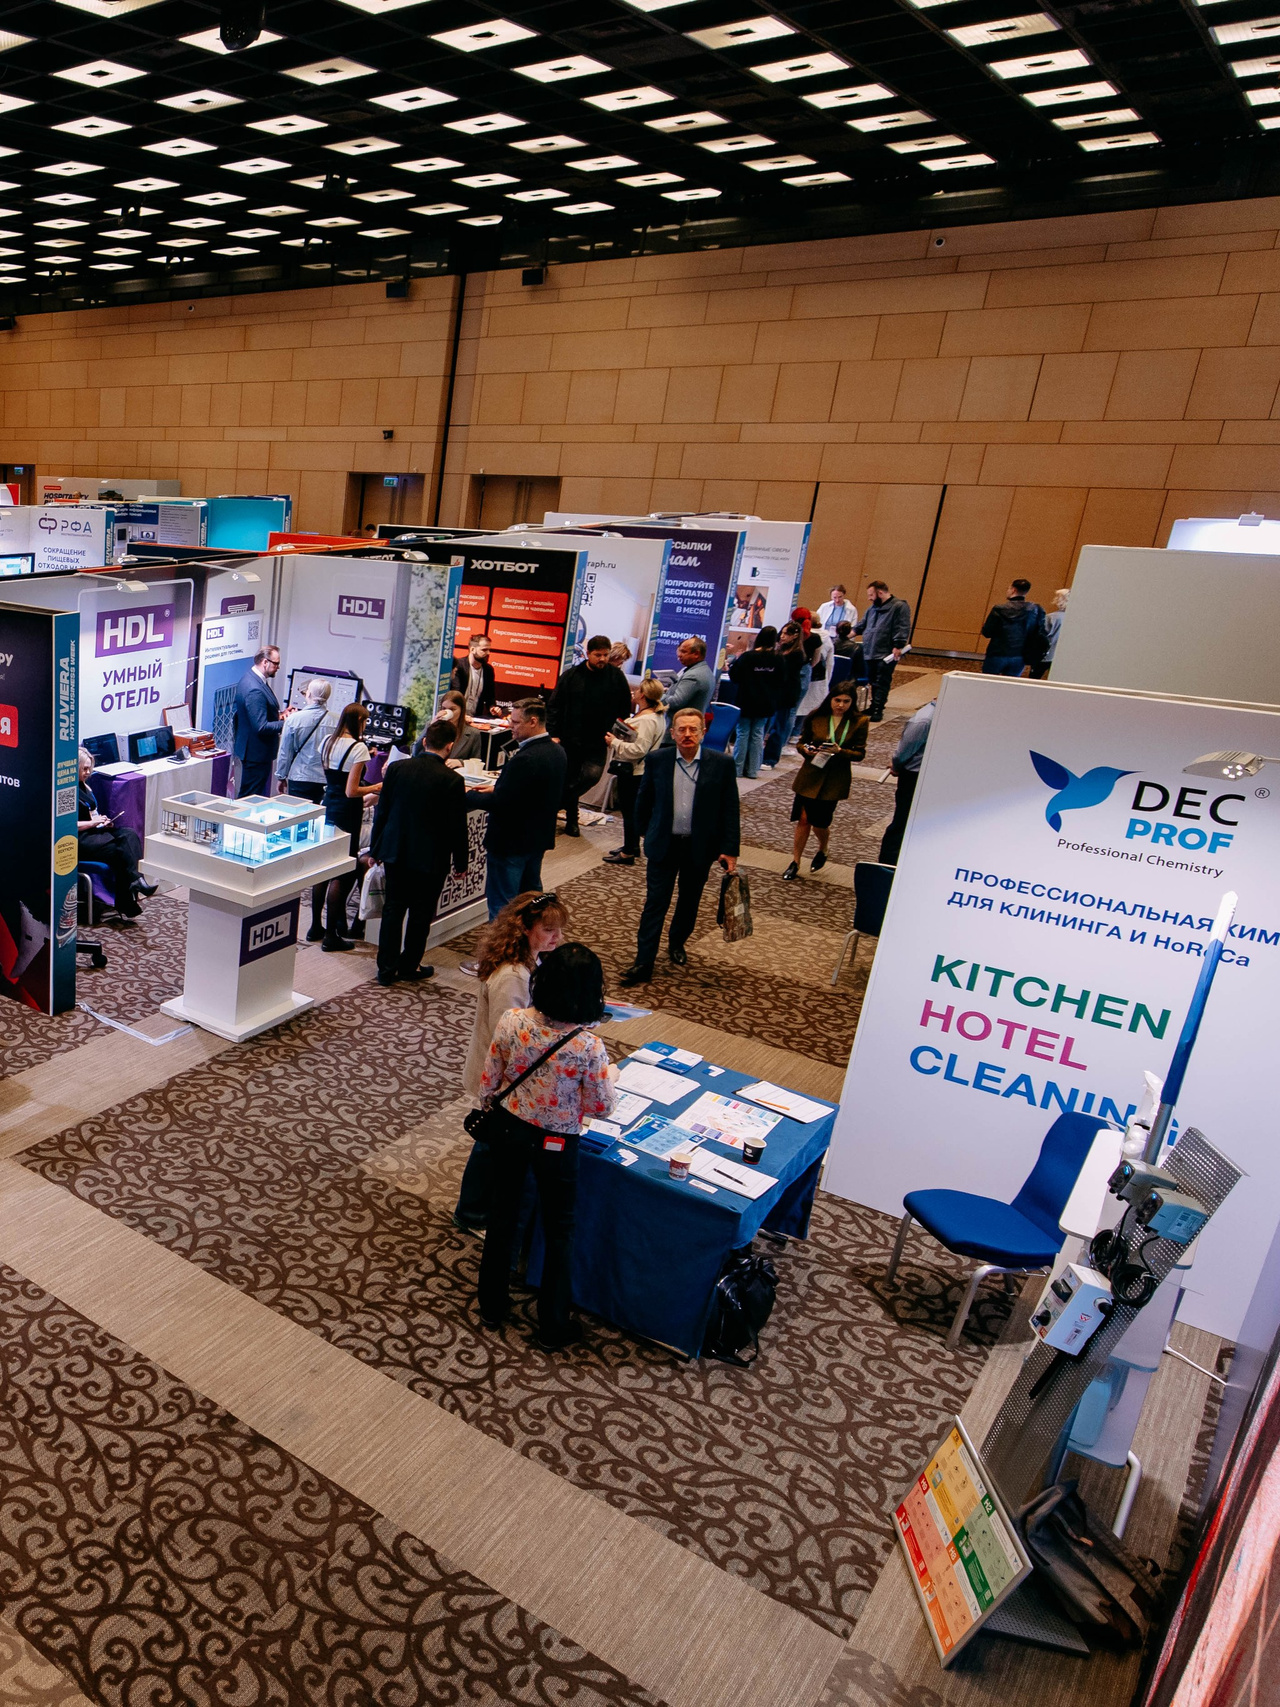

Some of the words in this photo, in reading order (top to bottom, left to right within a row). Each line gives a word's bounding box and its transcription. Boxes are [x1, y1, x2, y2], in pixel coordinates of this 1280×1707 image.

[61, 520, 92, 533] РФА
[43, 547, 86, 556] СОКРАЩЕНИЕ
[38, 562, 68, 570] ОТХОДОВ
[47, 555, 80, 564] ПИЩЕВЫХ
[587, 560, 617, 570] raph.ru
[470, 559, 540, 574] ХОТБОТ
[665, 579, 715, 590] ОПРОБУЙТЕ
[664, 588, 713, 599] БЕСПЛАТНО
[341, 599, 380, 616] HDL
[504, 597, 528, 605] Витрина
[570, 578, 581, 633] RUVIERA
[664, 597, 683, 605] 2000
[683, 599, 712, 607] ПИСЕМ
[682, 607, 711, 616] МЕСЯЦ
[103, 611, 165, 650] HDL
[206, 627, 223, 640] HDL
[442, 597, 456, 660] RUVIERA
[493, 628, 558, 641] Персонализированные
[509, 637, 538, 645] рассылки
[660, 630, 707, 643] ПРОМОКД
[204, 642, 239, 653] Интеллектуальные
[491, 661, 514, 670] Отзывы,
[514, 663, 546, 673] статистика
[505, 669, 535, 678] аналитика
[102, 660, 163, 689] УМНЫЙ
[59, 657, 70, 742] RUVIERA
[100, 685, 161, 713] ОТЕЛЬ
[57, 758, 78, 770] ЛУЧШАЯ
[57, 767, 70, 778] ЦЕНА
[57, 775, 76, 786] БИЛЕТЫ
[1130, 779, 1247, 827] DEC
[1124, 817, 1236, 855] PROF
[1056, 837, 1144, 862] Professional
[1145, 852, 1225, 879] Chemistry
[953, 867, 1214, 934] ПРОФЕССИОНАЛЬНАЯ
[947, 891, 994, 913] ДЛЯ
[998, 904, 1122, 941] КЛИНИНГА
[1130, 928, 1148, 945] И
[252, 919, 285, 947] HDL
[929, 953, 1173, 1041] KITCHEN
[918, 998, 1089, 1072] HOTEL
[908, 1044, 1181, 1147] CLEANIN
